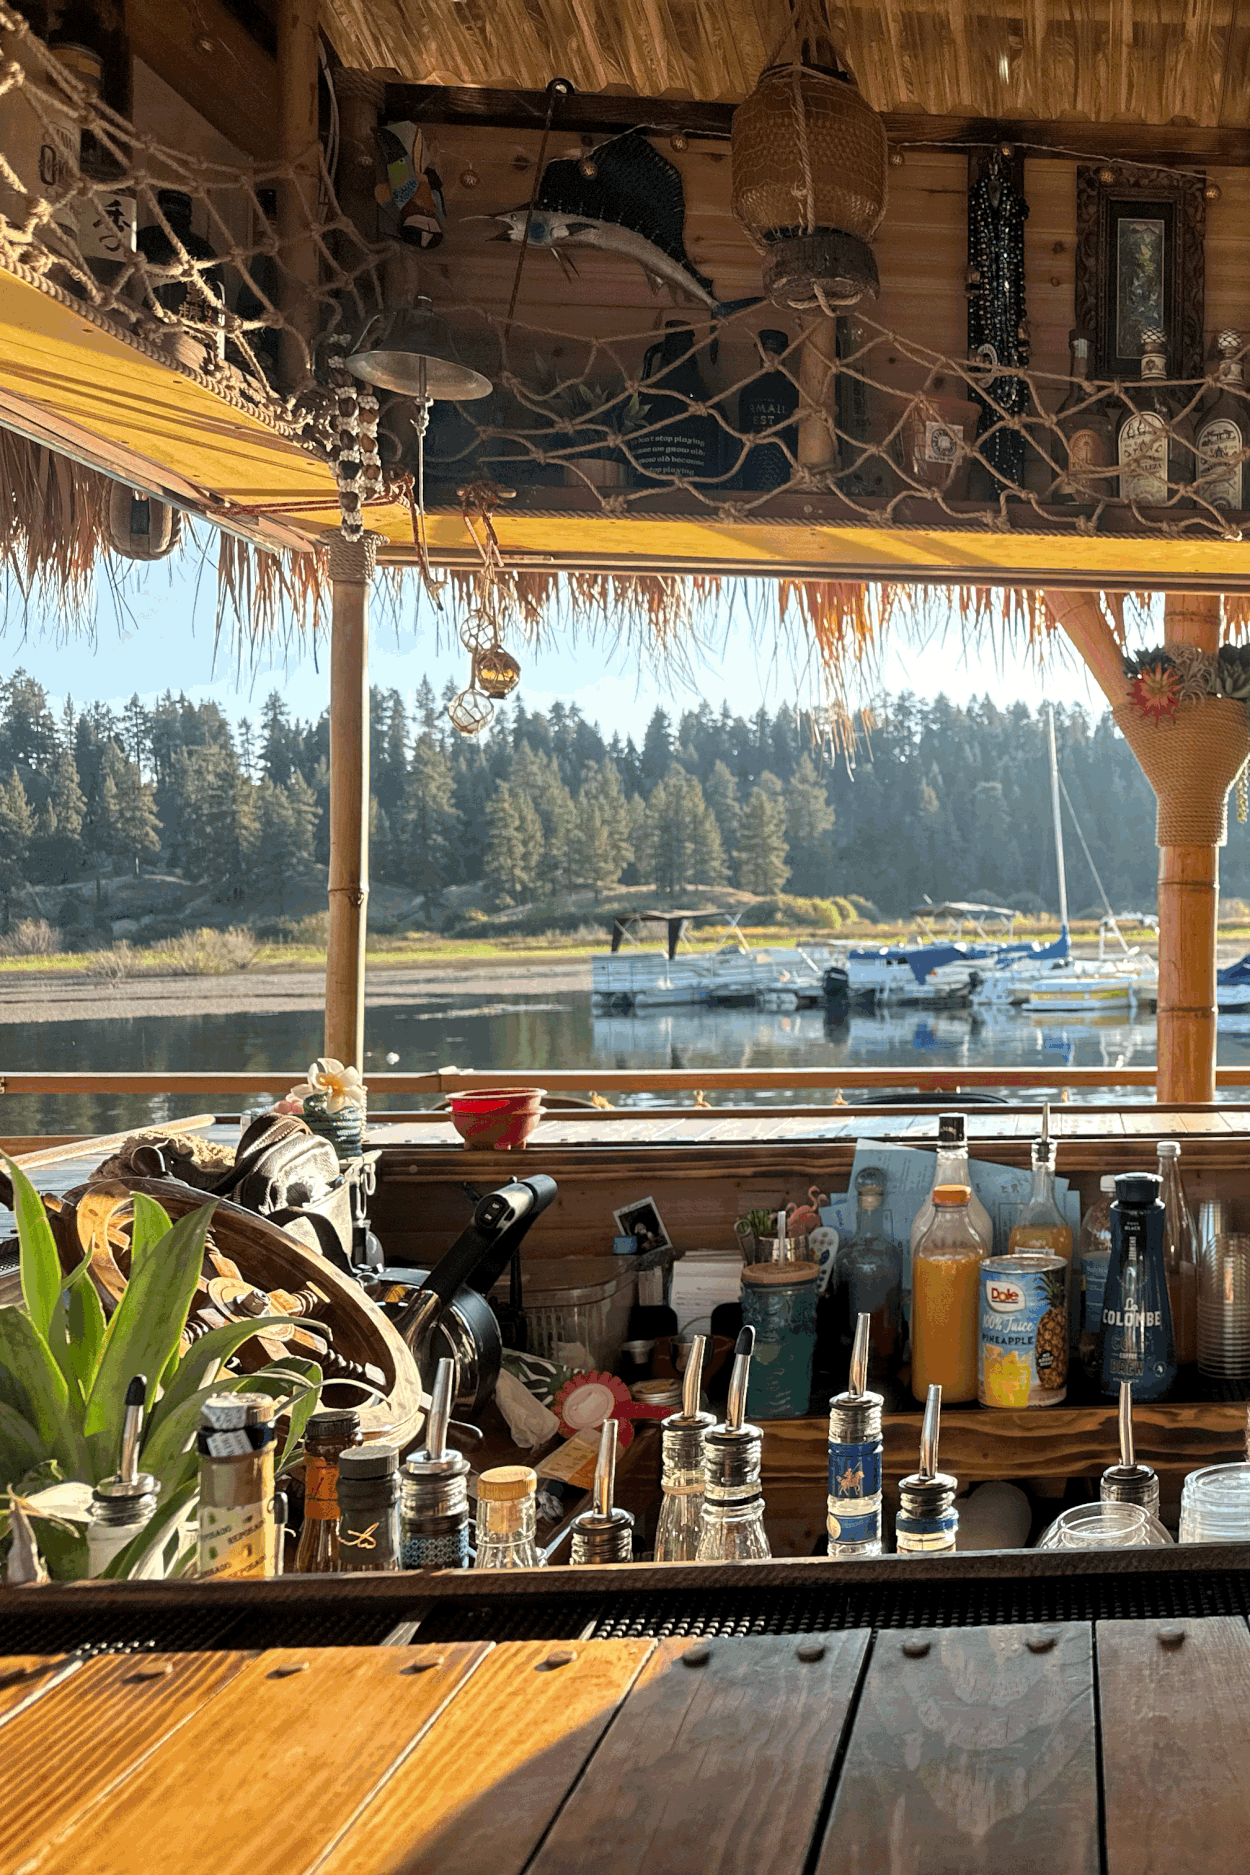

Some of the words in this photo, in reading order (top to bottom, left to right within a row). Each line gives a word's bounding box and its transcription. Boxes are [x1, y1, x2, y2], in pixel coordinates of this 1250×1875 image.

[991, 1288, 1019, 1302] Dole
[1002, 1315, 1034, 1333] Juice
[1102, 1309, 1161, 1327] COLOMBE
[982, 1333, 1034, 1345] PINEAPPLE
